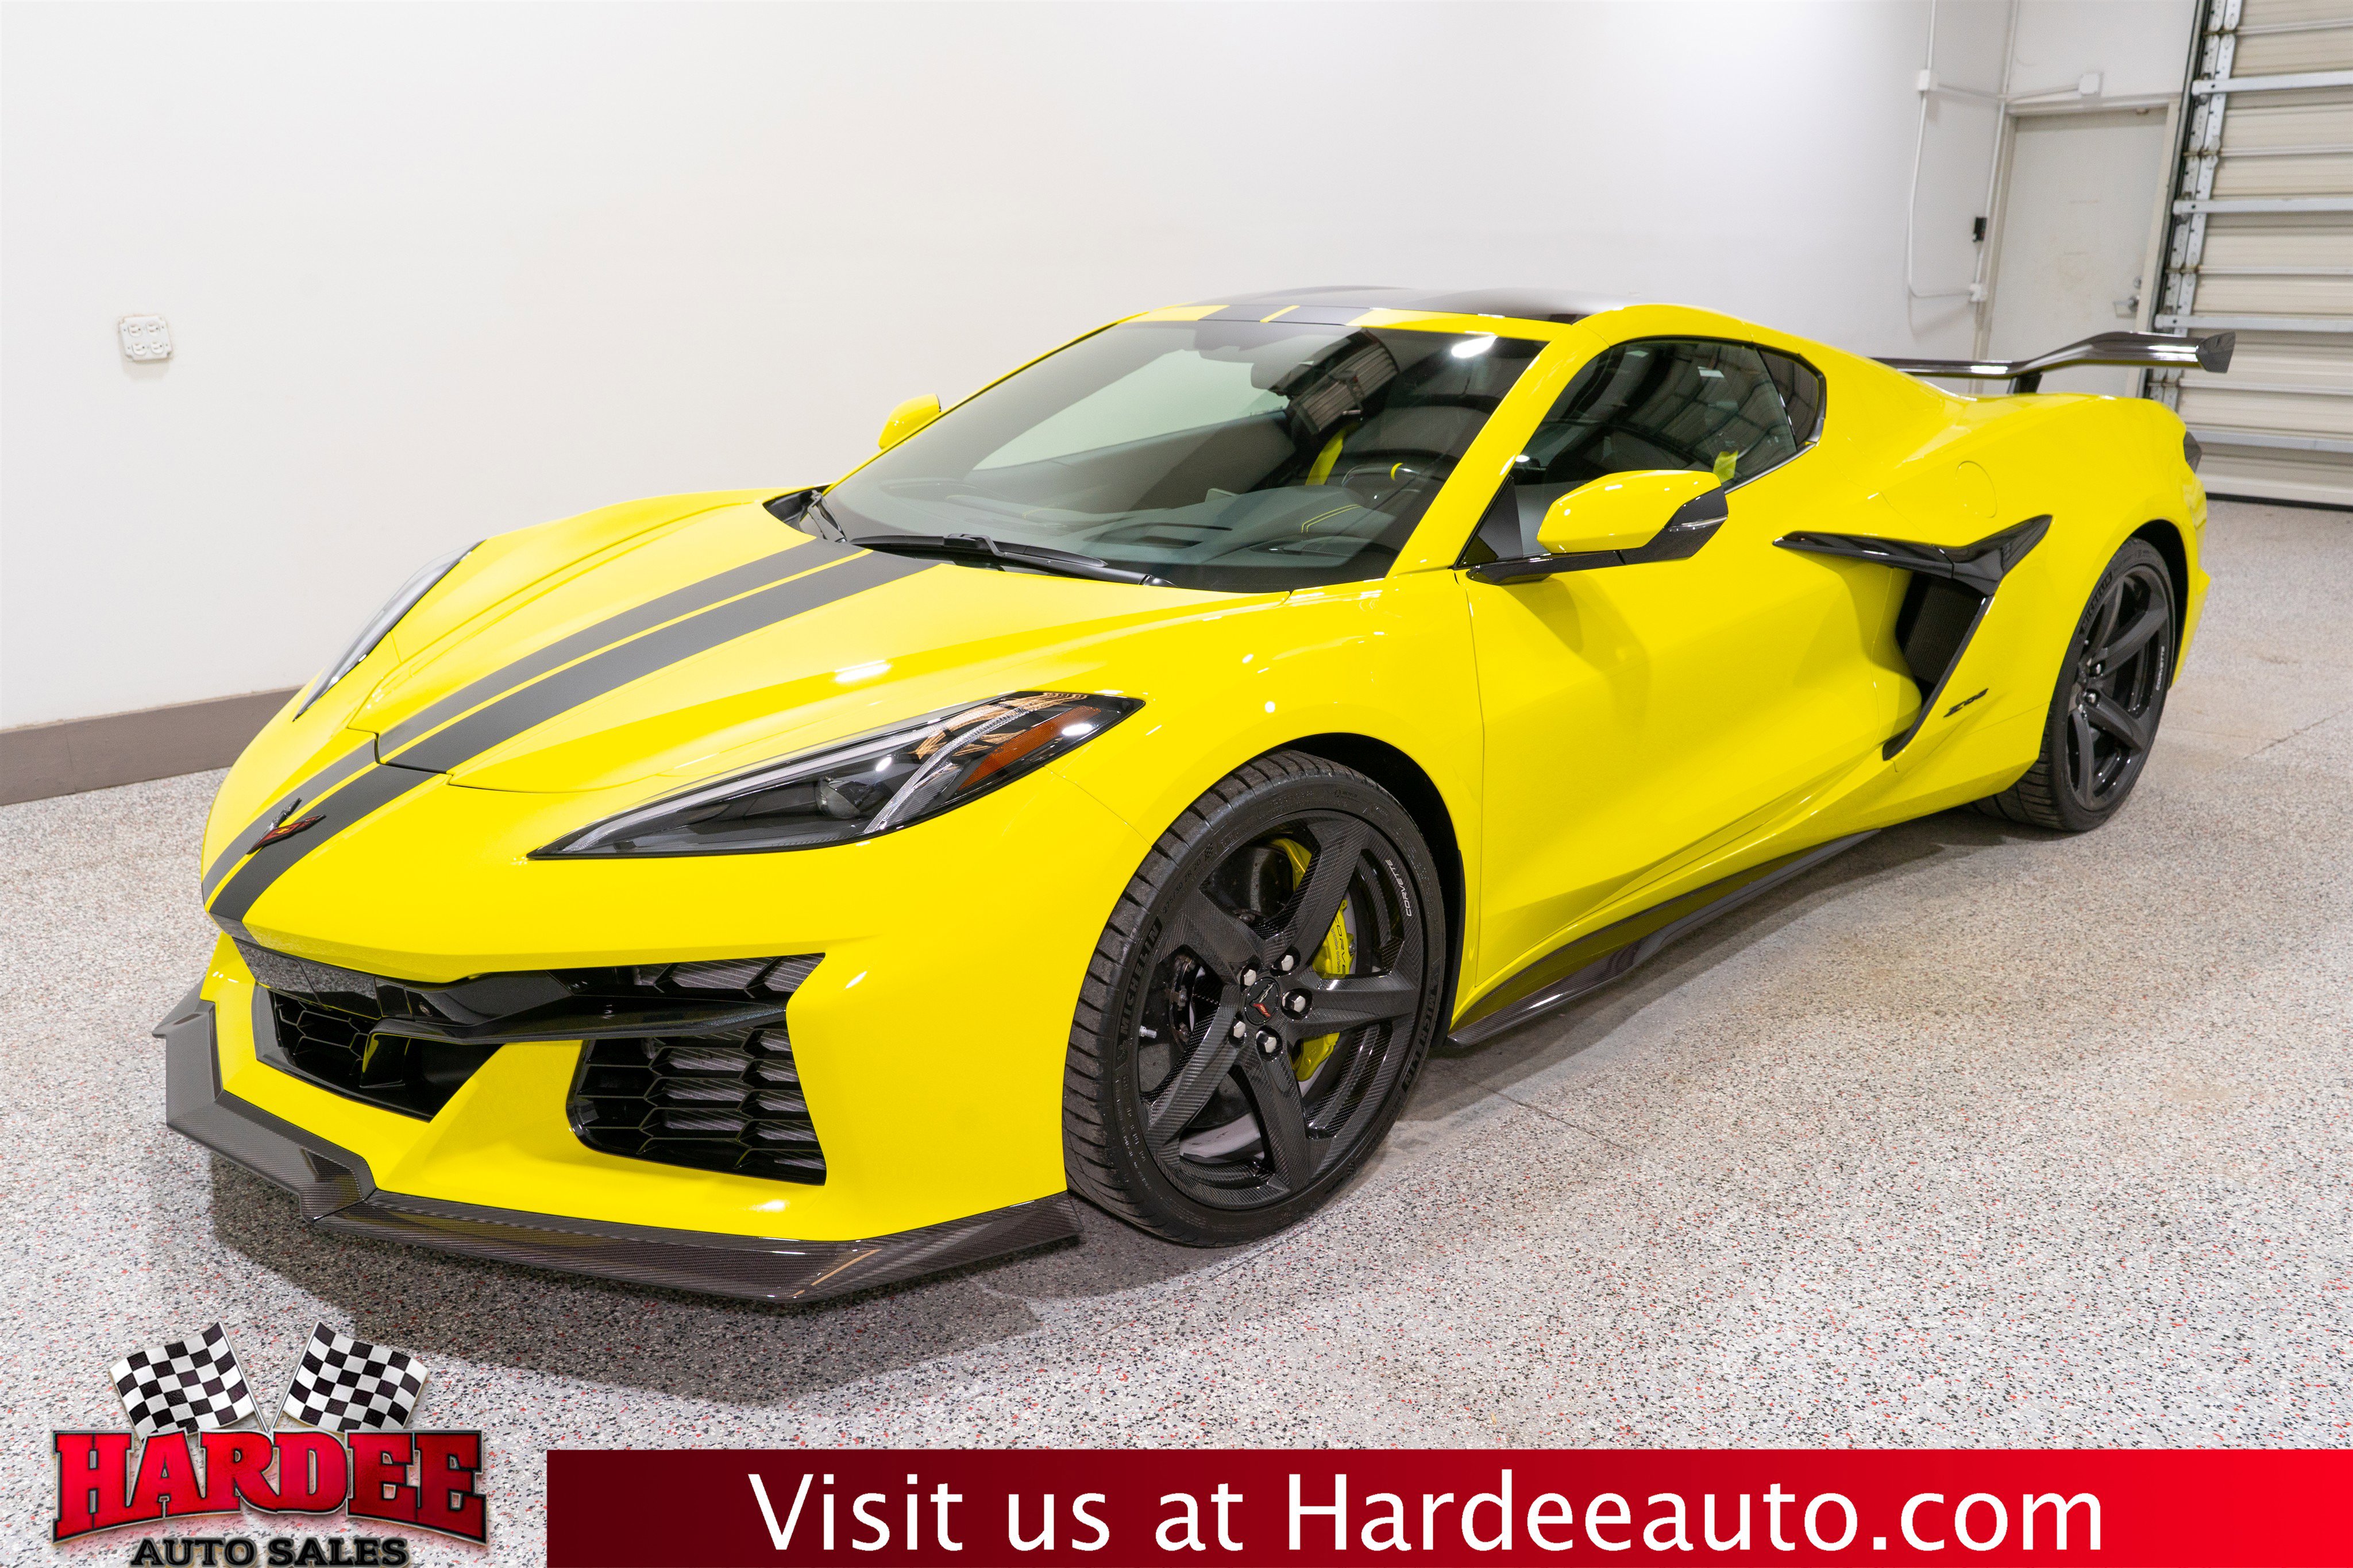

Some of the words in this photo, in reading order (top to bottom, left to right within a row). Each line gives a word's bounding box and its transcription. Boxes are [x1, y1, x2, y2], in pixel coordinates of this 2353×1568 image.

[1385, 859, 1412, 917] CORVETTE
[1121, 922, 1162, 1035] MICHELIN
[1403, 994, 1436, 1086] MICHELIN
